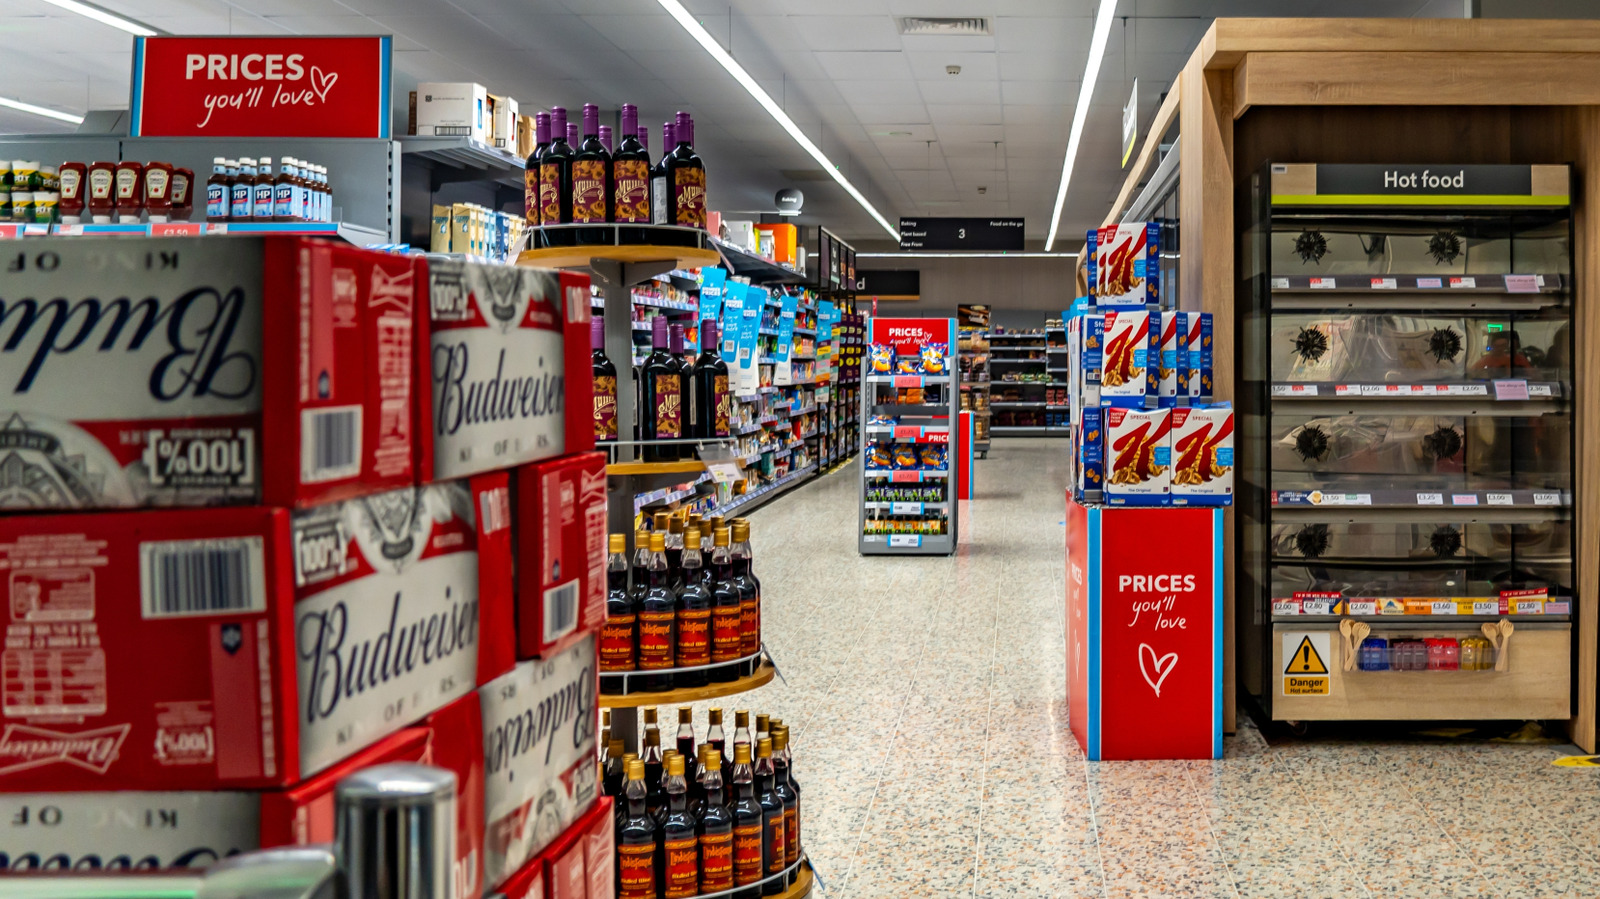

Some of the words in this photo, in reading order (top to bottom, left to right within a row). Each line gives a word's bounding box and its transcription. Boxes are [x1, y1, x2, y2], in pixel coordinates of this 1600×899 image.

[185, 53, 304, 81] PRICES
[196, 86, 263, 128] you'll
[271, 83, 315, 108] love
[1384, 170, 1417, 189] Hot
[1421, 170, 1464, 188] food
[208, 190, 221, 199] HP
[233, 190, 246, 199] HP
[256, 190, 270, 199] HP
[277, 190, 290, 199] HP
[958, 228, 966, 239] 3
[7, 250, 61, 272] OF
[888, 327, 923, 337] PRICES
[432, 341, 565, 437] Budweiser
[155, 438, 245, 475] 100%
[1119, 574, 1196, 593] PRICES
[1127, 594, 1176, 628] you'll
[1154, 613, 1187, 632] love
[299, 586, 480, 725] Budweiser
[1289, 678, 1324, 688] Danger
[484, 665, 596, 782] Budweiser
[10, 805, 63, 830] OF
